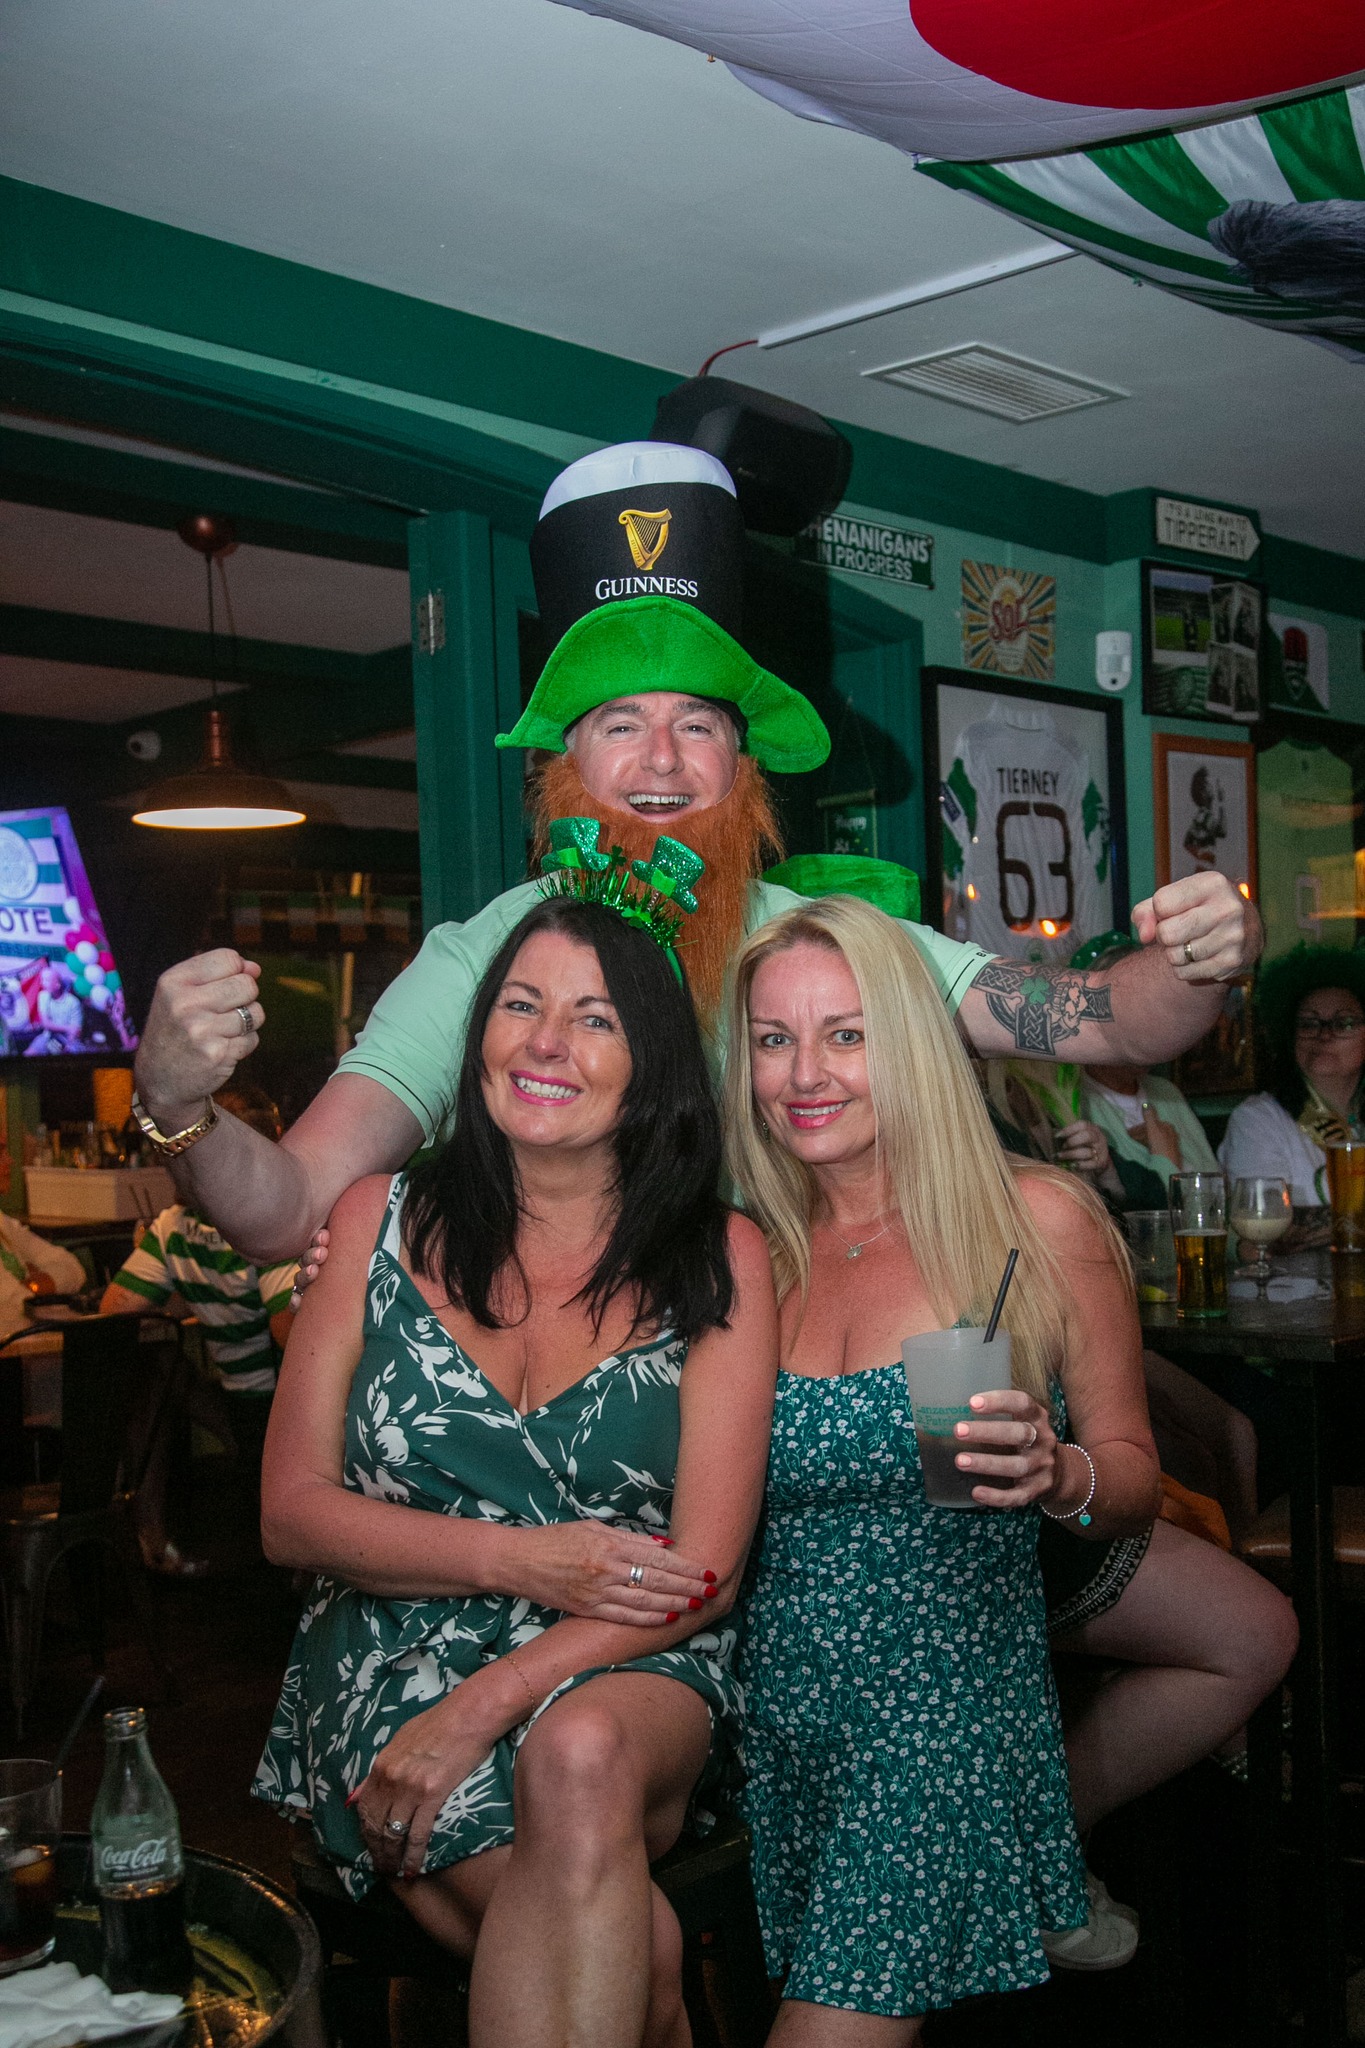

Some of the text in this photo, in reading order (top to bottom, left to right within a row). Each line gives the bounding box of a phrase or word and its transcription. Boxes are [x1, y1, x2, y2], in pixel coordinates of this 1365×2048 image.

[1164, 516, 1249, 556] TIPPERARY
[835, 544, 913, 580] PROGRESS
[595, 576, 699, 600] GUINNESS
[996, 767, 1061, 796] TIERNEY
[996, 801, 1075, 931] 63
